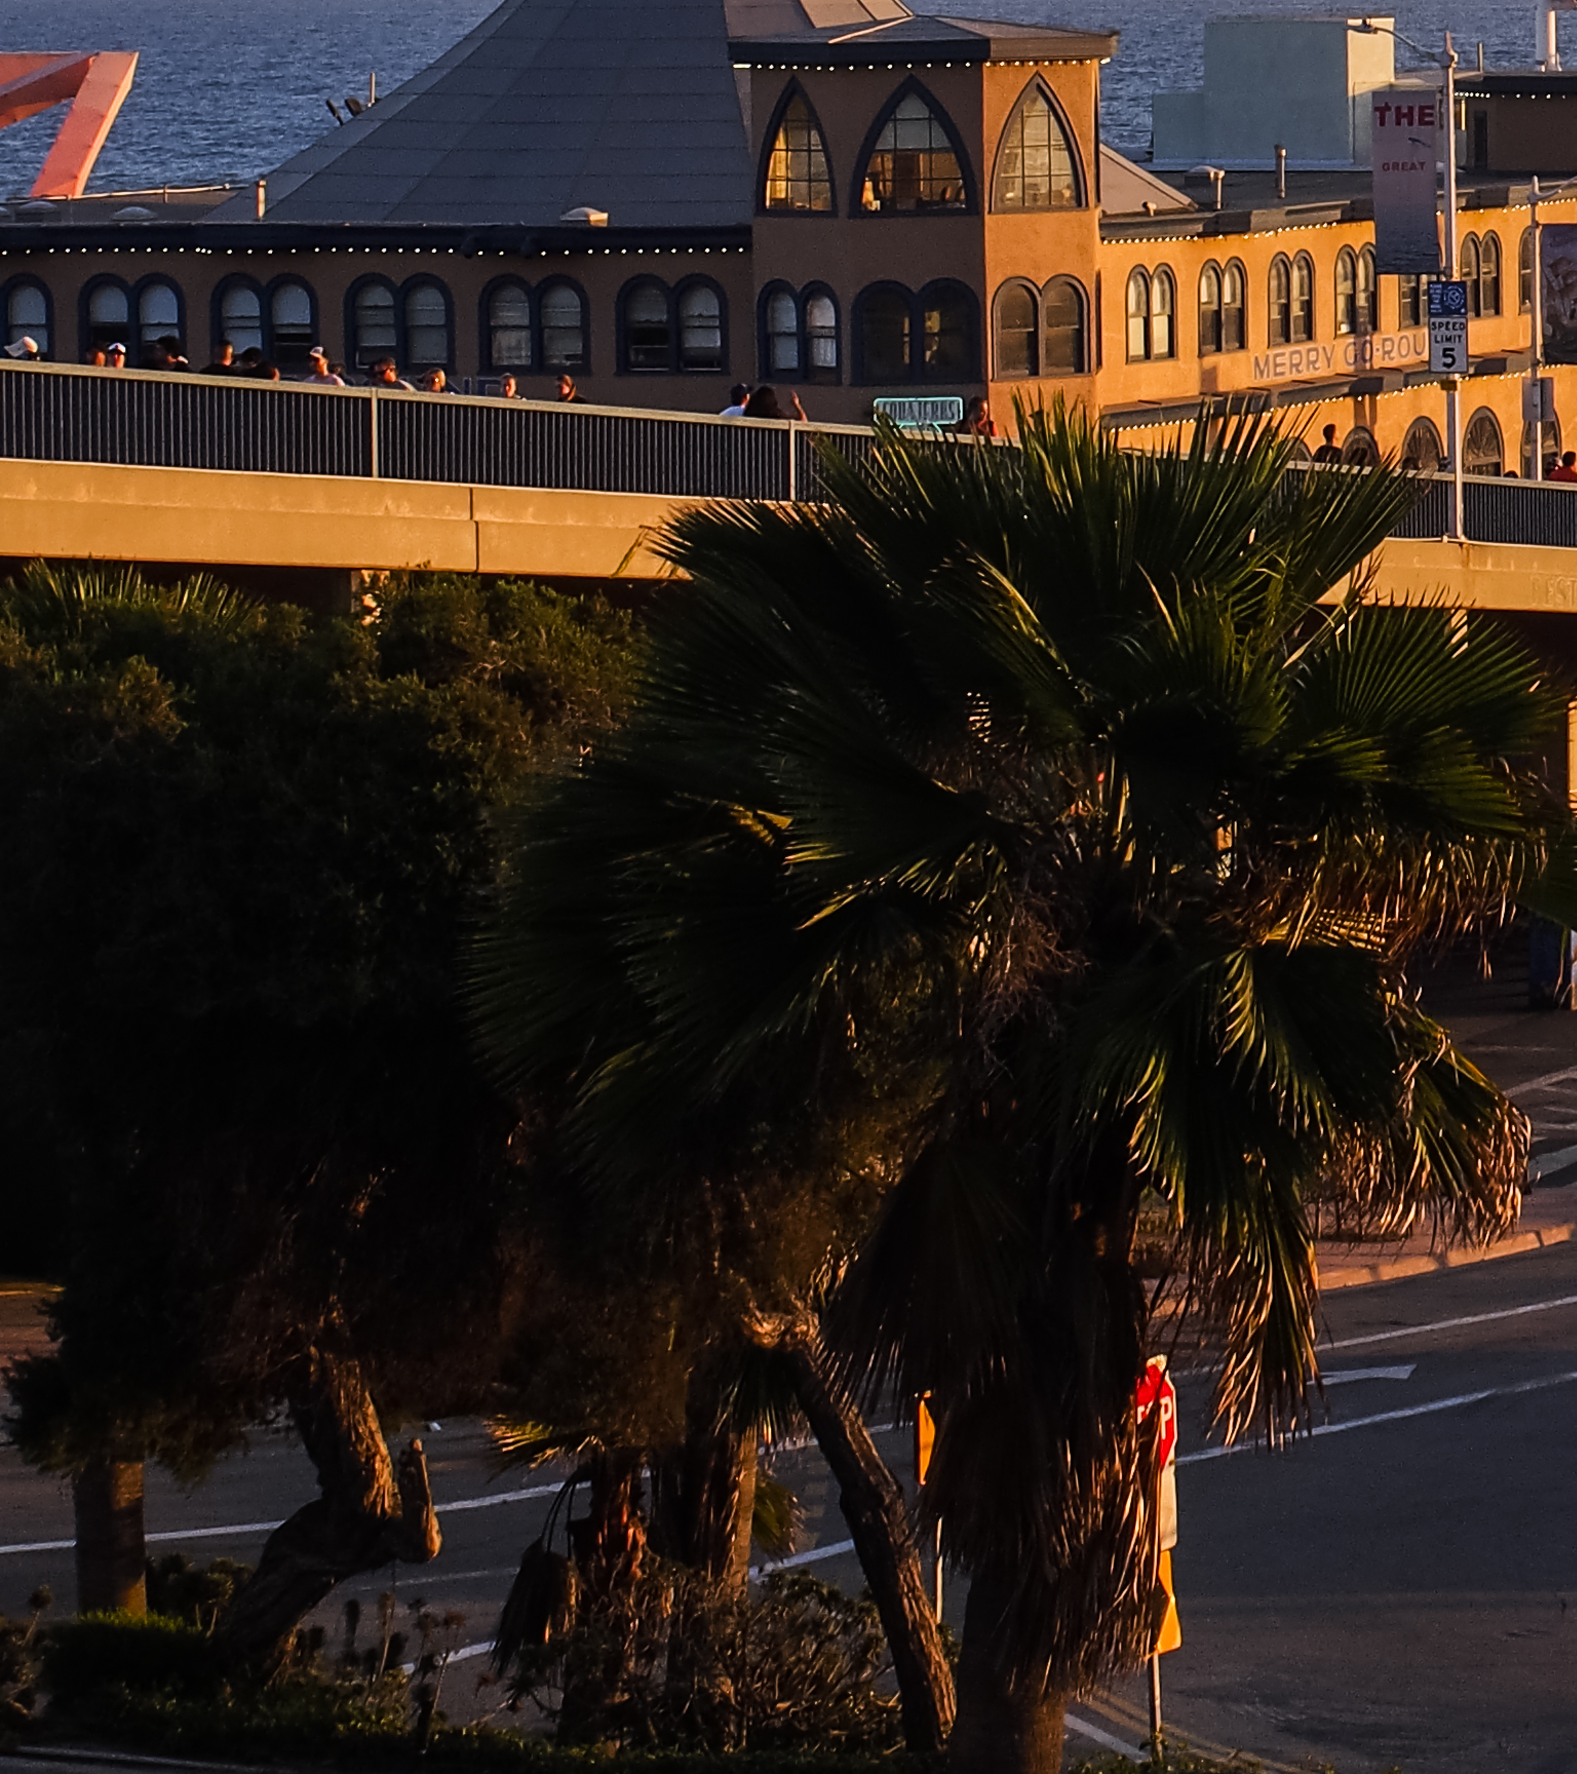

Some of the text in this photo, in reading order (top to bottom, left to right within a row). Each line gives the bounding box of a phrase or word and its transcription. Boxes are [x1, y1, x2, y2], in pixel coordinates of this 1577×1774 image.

[1374, 102, 1436, 127] THE
[1382, 161, 1426, 172] GREAT
[1431, 321, 1465, 331] SPEED
[1434, 334, 1462, 344] LIMIT
[1254, 331, 1426, 380] MERRY GO-ROU
[1442, 347, 1456, 369] 5
